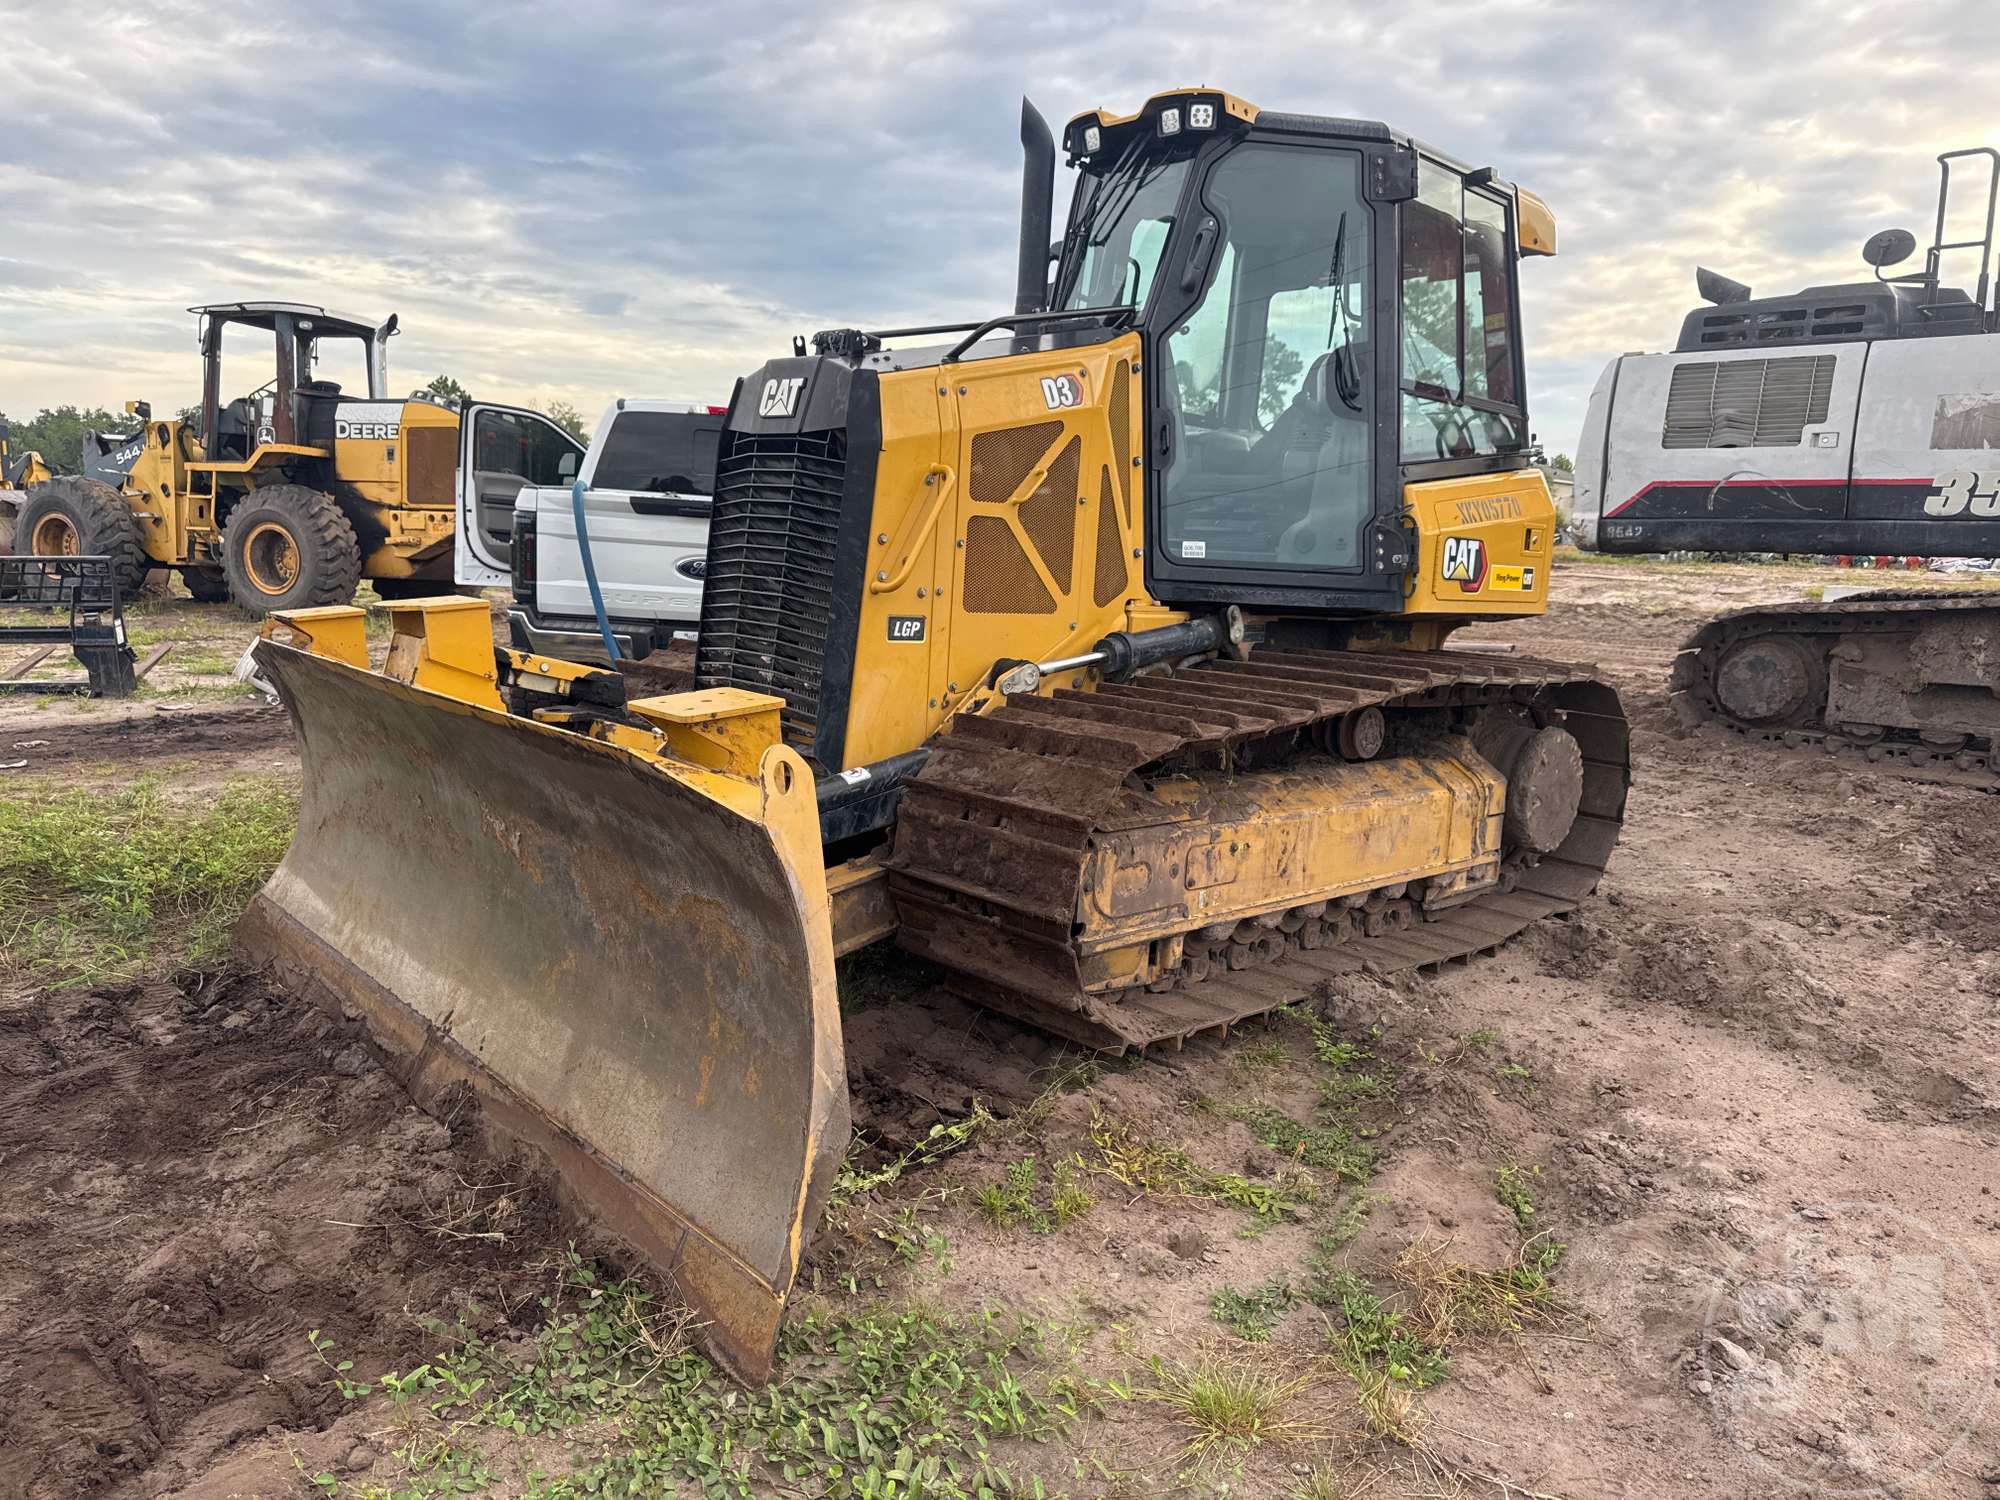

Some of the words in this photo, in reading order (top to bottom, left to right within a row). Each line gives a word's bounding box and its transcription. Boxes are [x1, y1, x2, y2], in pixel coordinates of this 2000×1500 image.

[759, 378, 804, 416] CAT
[1040, 376, 1073, 409] D3
[336, 419, 400, 440] DEERE
[1444, 538, 1480, 580] CAT
[893, 621, 921, 637] LGP
